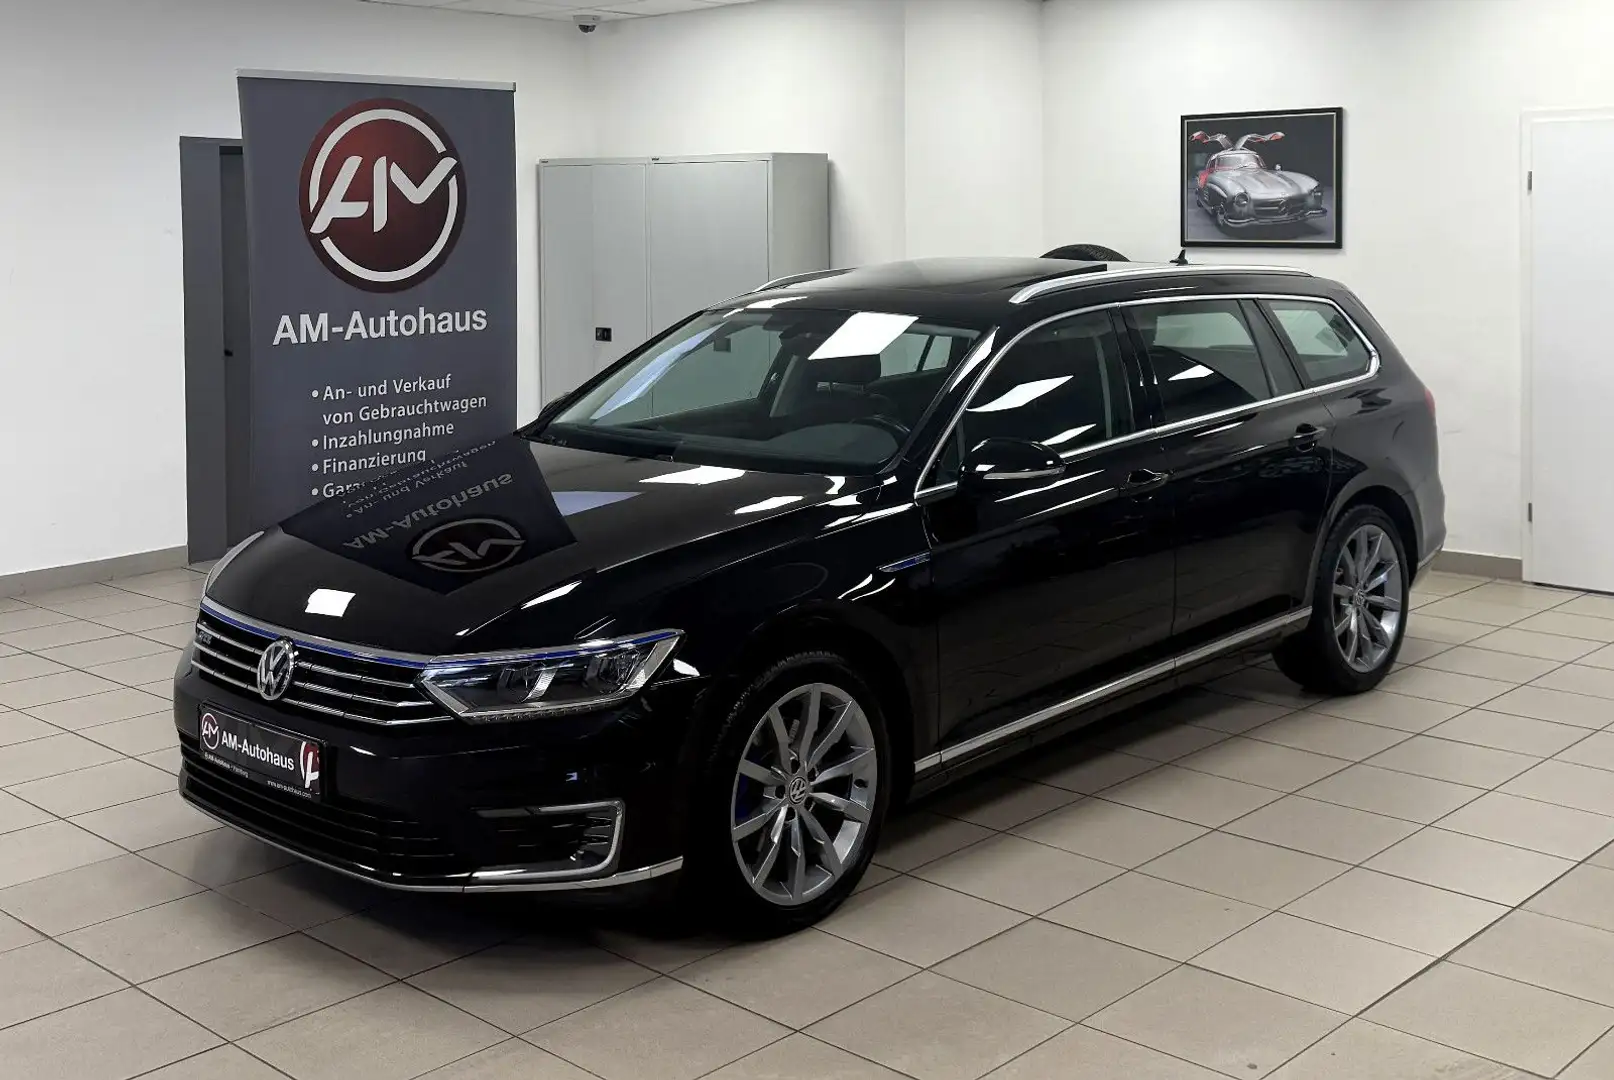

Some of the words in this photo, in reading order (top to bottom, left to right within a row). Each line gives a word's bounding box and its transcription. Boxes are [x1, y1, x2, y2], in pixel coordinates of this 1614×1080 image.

[309, 155, 458, 234] AM
[272, 306, 488, 346] AM-Autohaus
[323, 385, 352, 401] An-
[358, 379, 388, 398] und
[393, 373, 452, 395] Verkauf
[322, 411, 354, 426] von
[359, 395, 488, 421] Gebrauchtwagen
[323, 422, 455, 450] Inzahlungnahme
[322, 450, 427, 475] Finanzierung
[221, 730, 295, 771] AM-Autohaus
